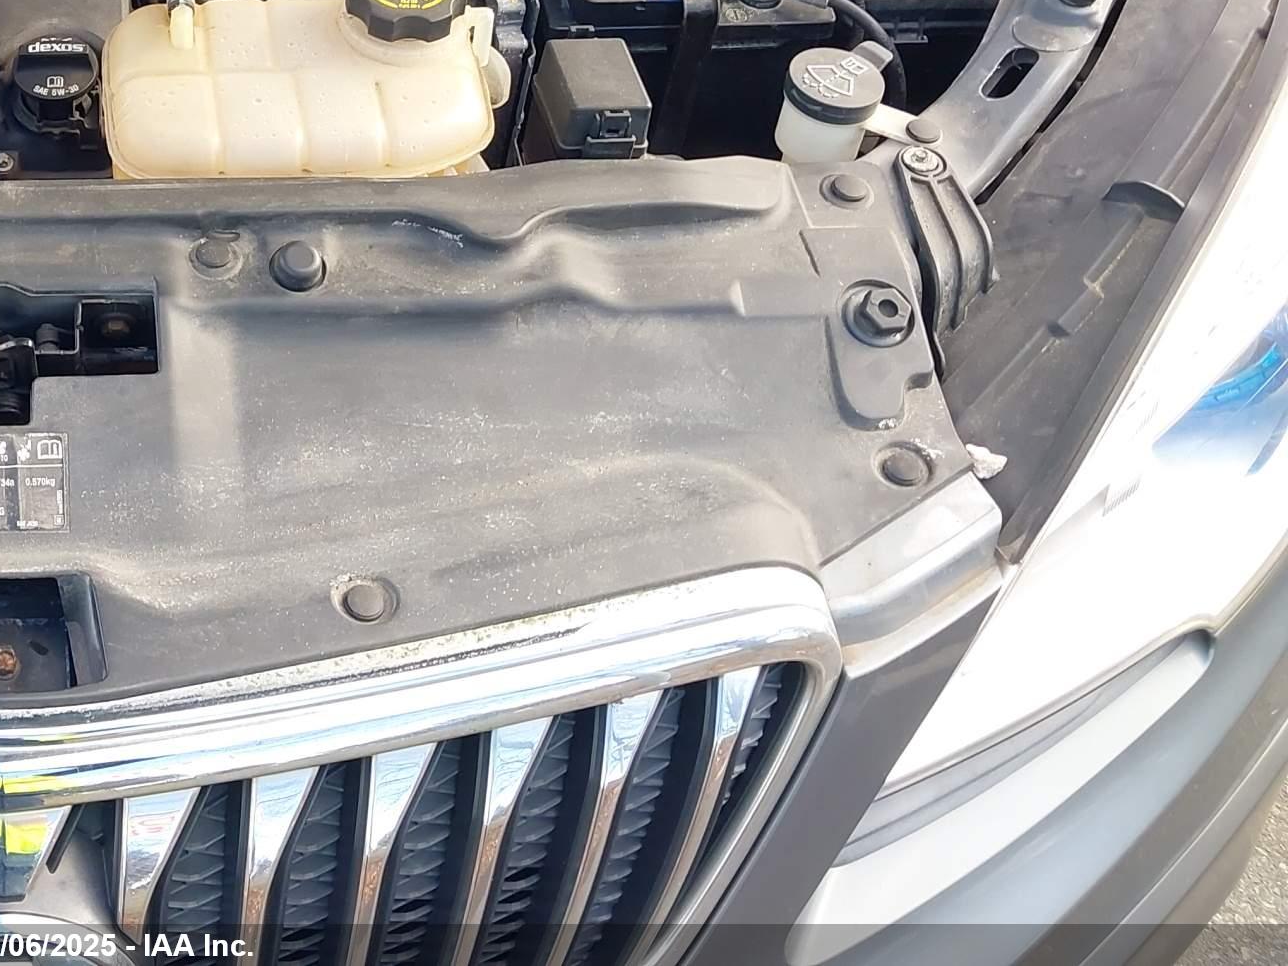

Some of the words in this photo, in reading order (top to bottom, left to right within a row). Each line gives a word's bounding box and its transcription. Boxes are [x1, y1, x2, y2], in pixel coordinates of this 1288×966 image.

[27, 41, 84, 53] dexos
[32, 84, 49, 96] SAE
[51, 84, 80, 96] 5W-30
